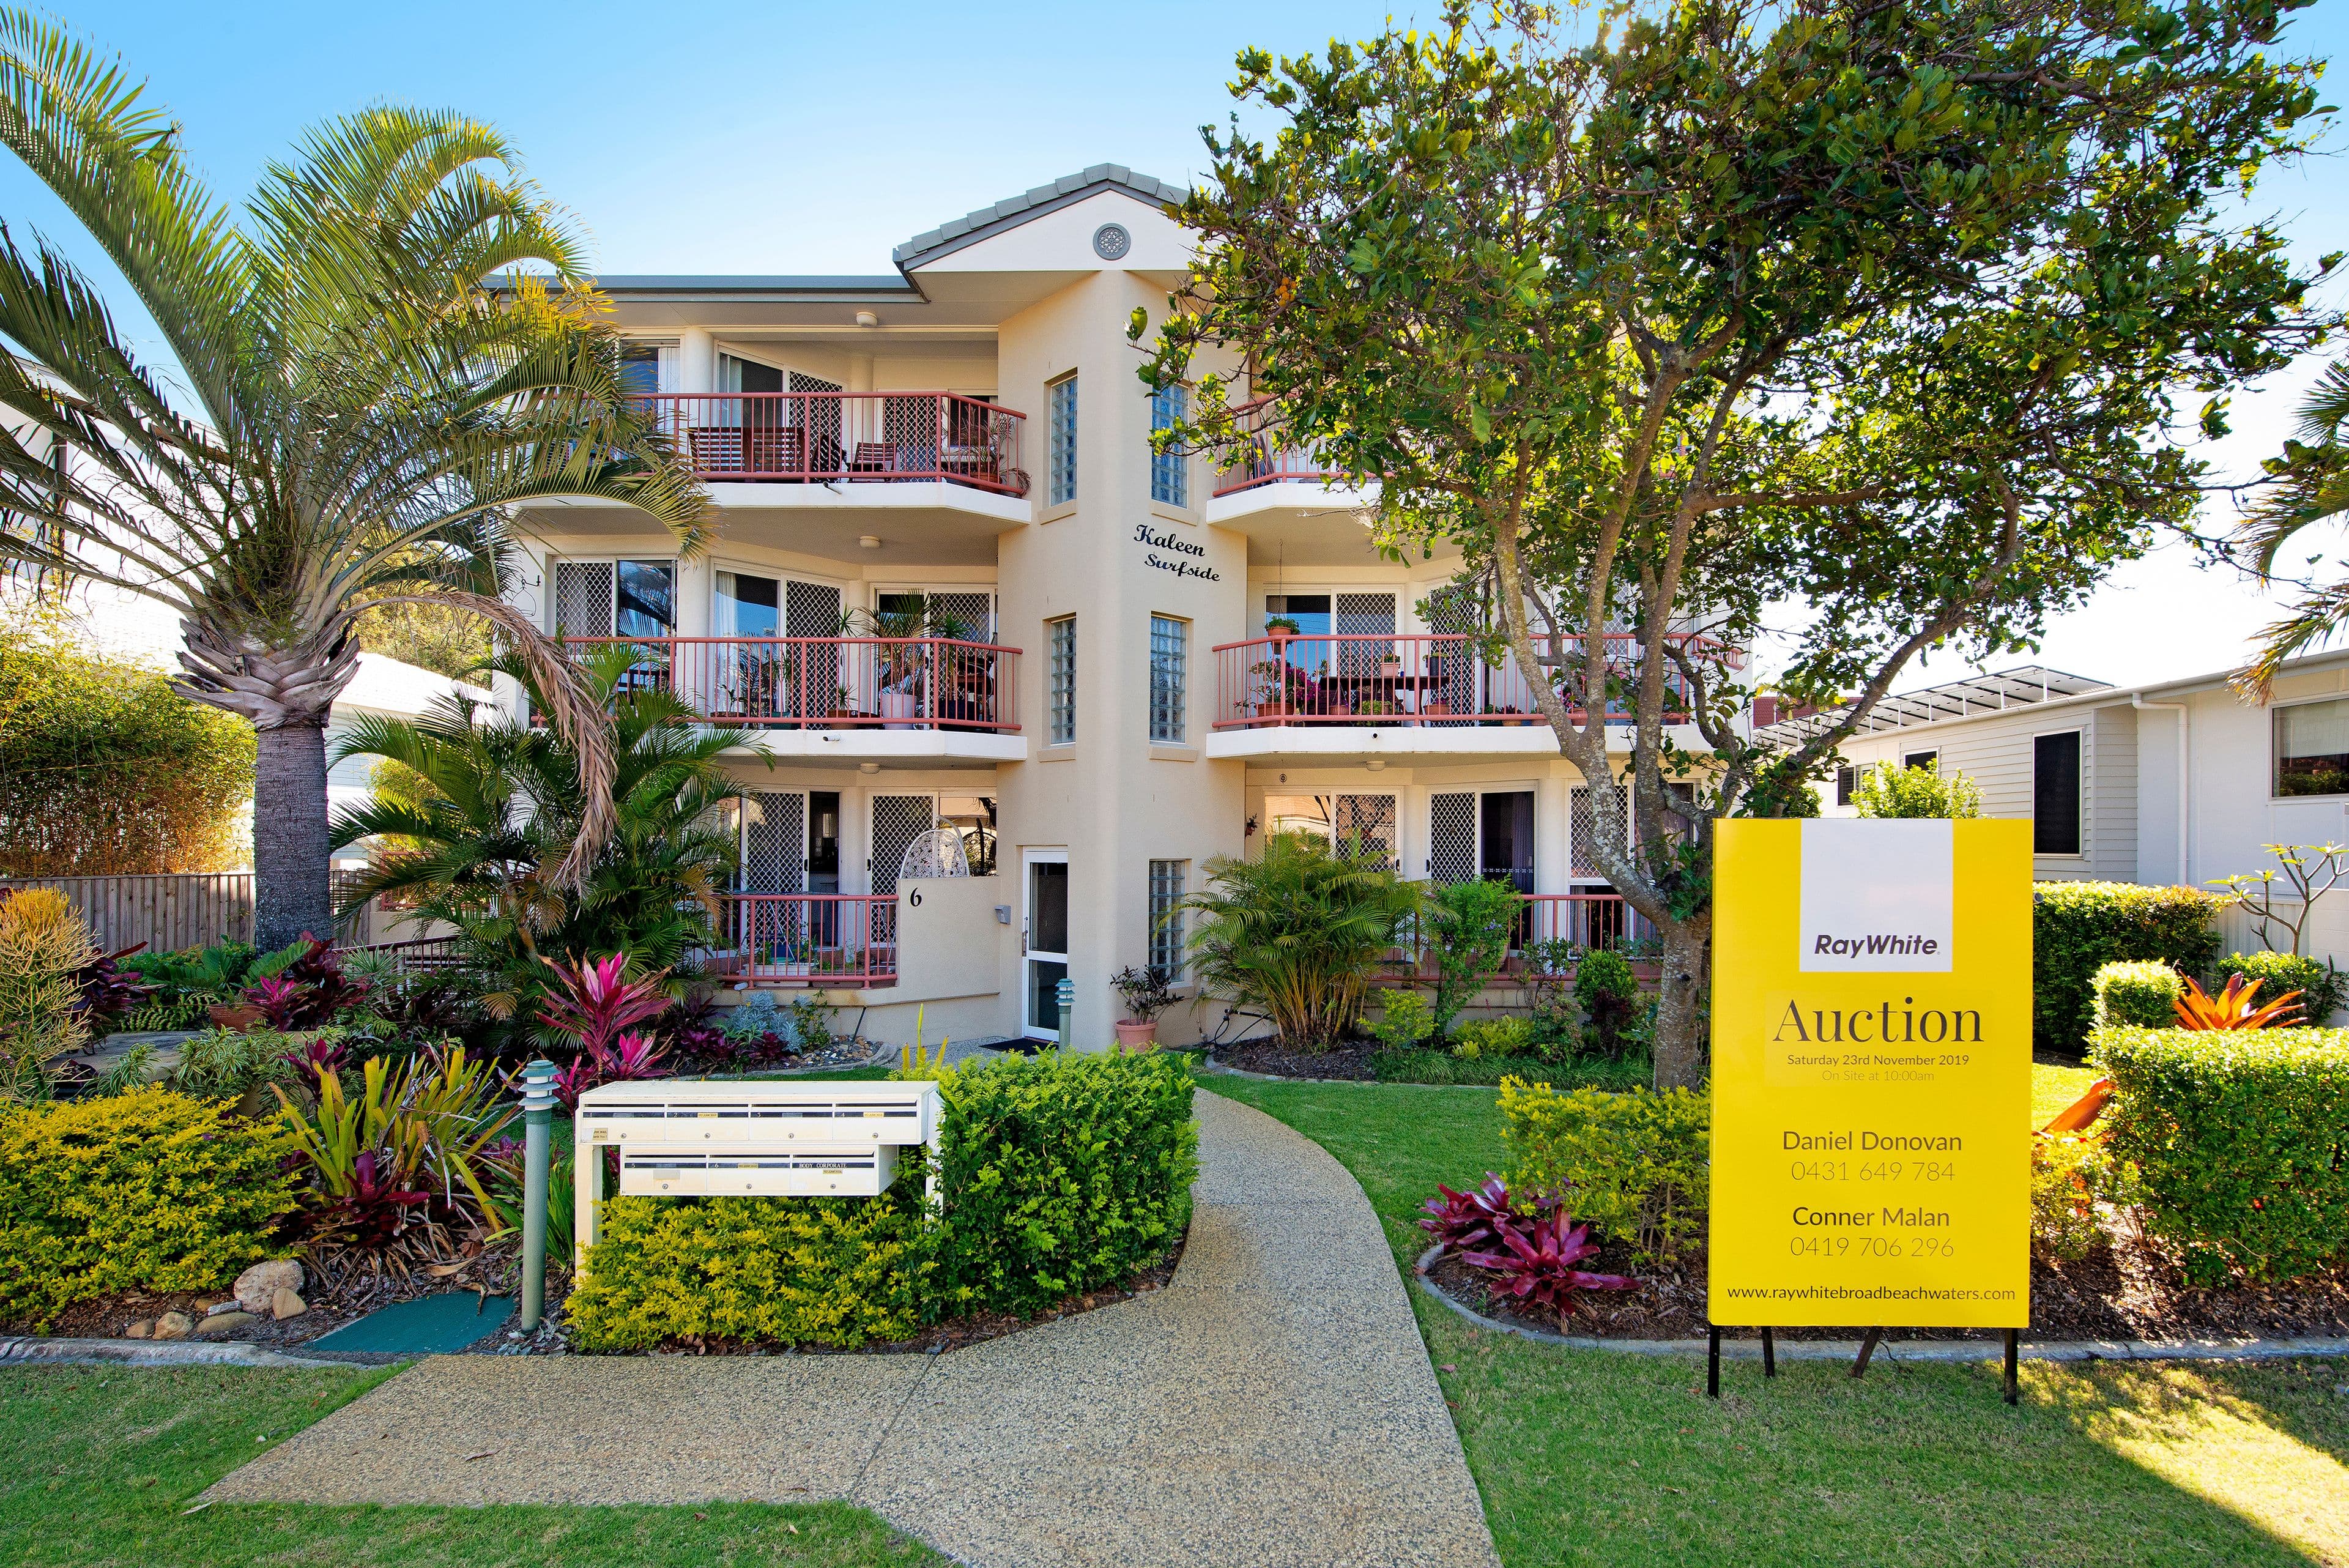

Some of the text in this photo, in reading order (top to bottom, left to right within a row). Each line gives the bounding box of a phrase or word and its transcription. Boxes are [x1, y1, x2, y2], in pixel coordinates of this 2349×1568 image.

[1134, 524, 1205, 557] Kaleen
[1144, 553, 1220, 581] Surfside
[910, 887, 922, 907] 6
[1772, 996, 1984, 1044] Auction
[1787, 1053, 1969, 1067] Saturday 23rd November 2019
[1822, 1069, 1935, 1082] On Site at 10:00am
[1783, 1130, 1962, 1151] Daniel Donovan
[1791, 1161, 1956, 1182] 0431 649 784
[1792, 1206, 1950, 1227] Conner Malan
[1790, 1236, 1955, 1258] 0419 706 296
[1727, 1285, 2016, 1301] www.raywhitebroadbeachwaters.com
